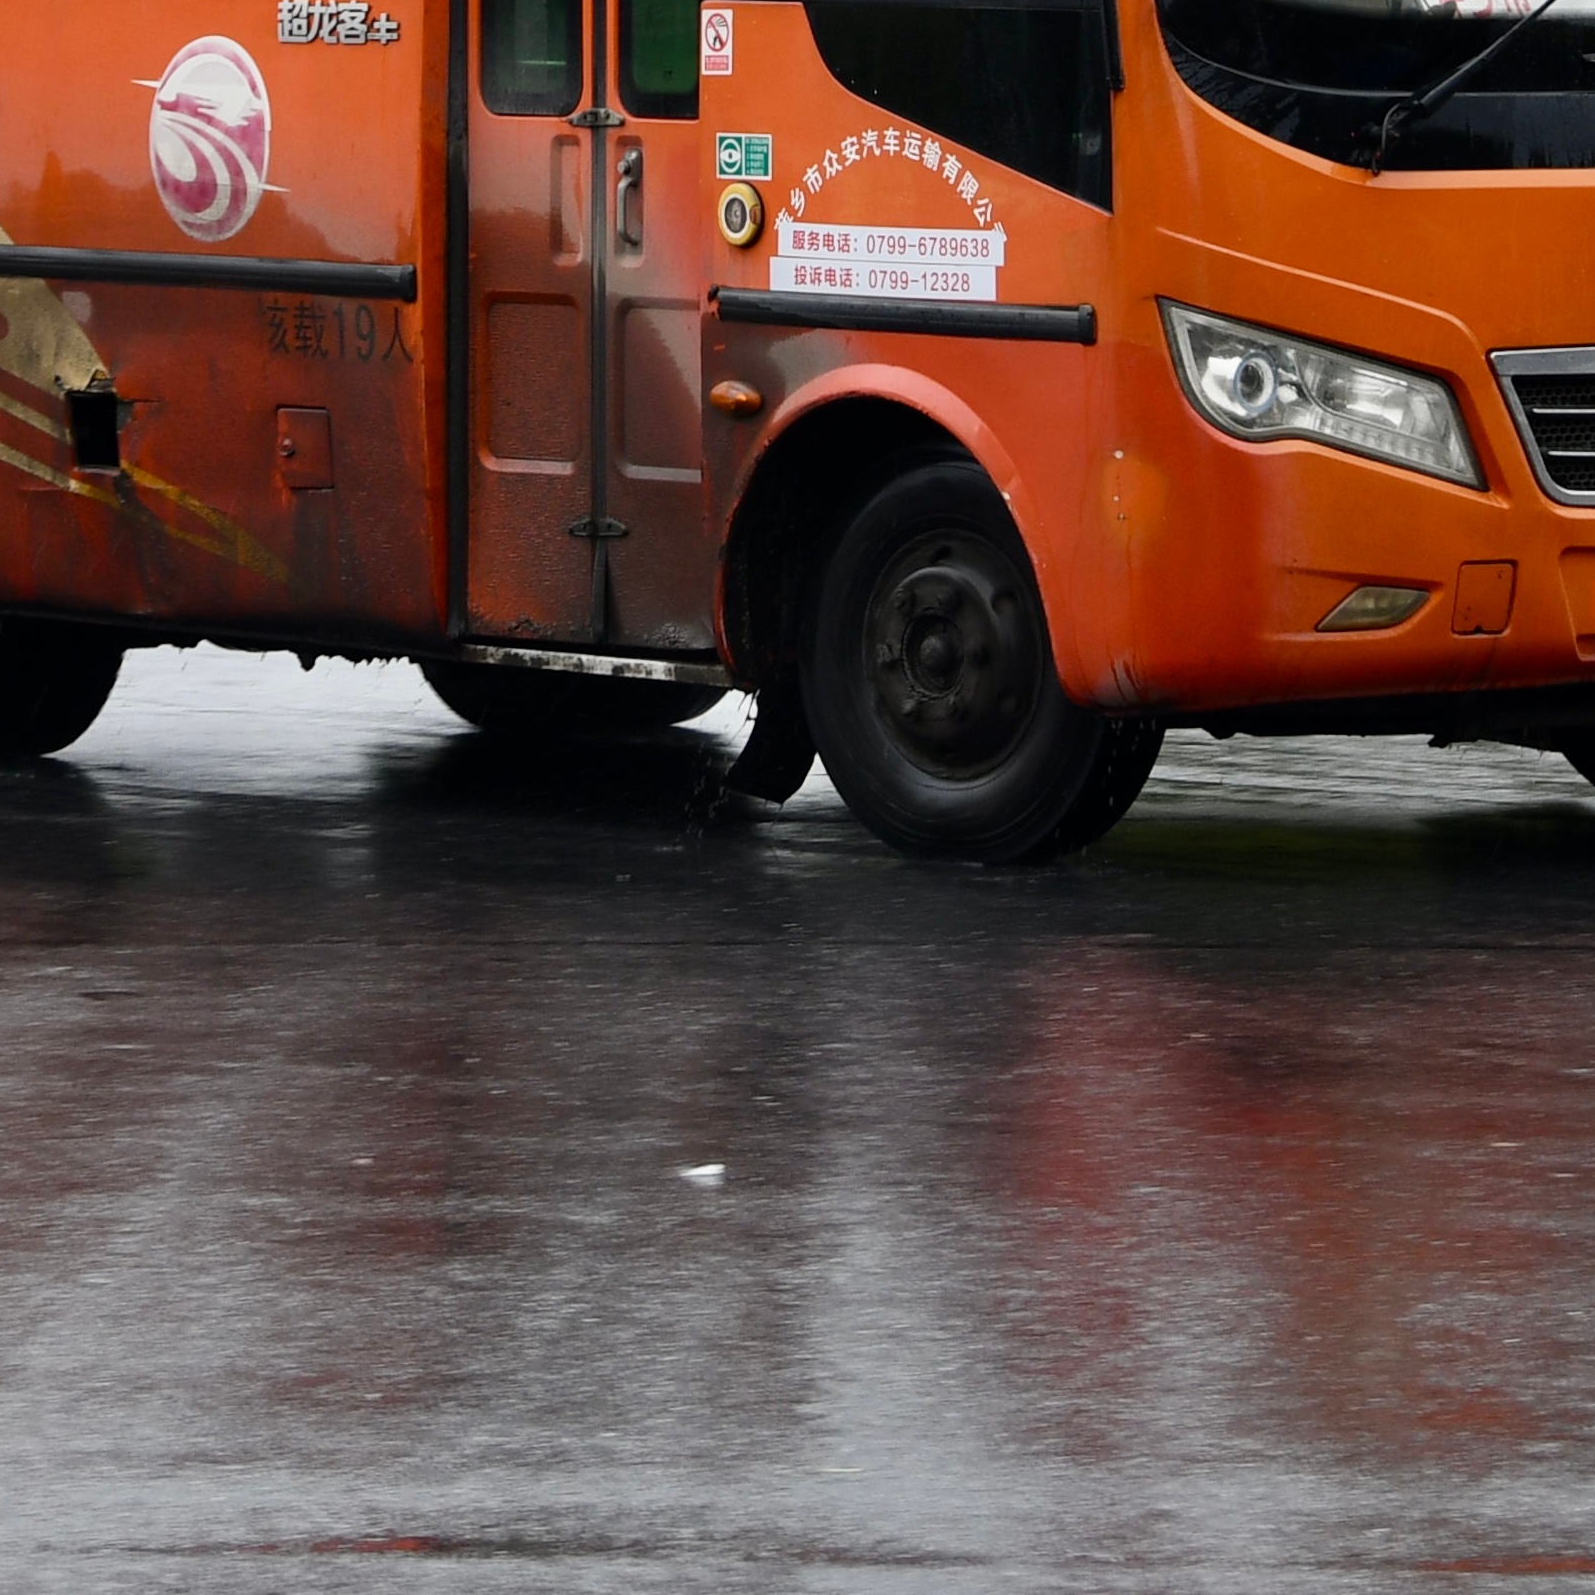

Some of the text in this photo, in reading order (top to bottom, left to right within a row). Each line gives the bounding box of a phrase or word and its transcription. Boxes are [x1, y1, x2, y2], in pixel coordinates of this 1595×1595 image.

[774, 126, 1008, 242] 乡市众安汽车运输有限公
